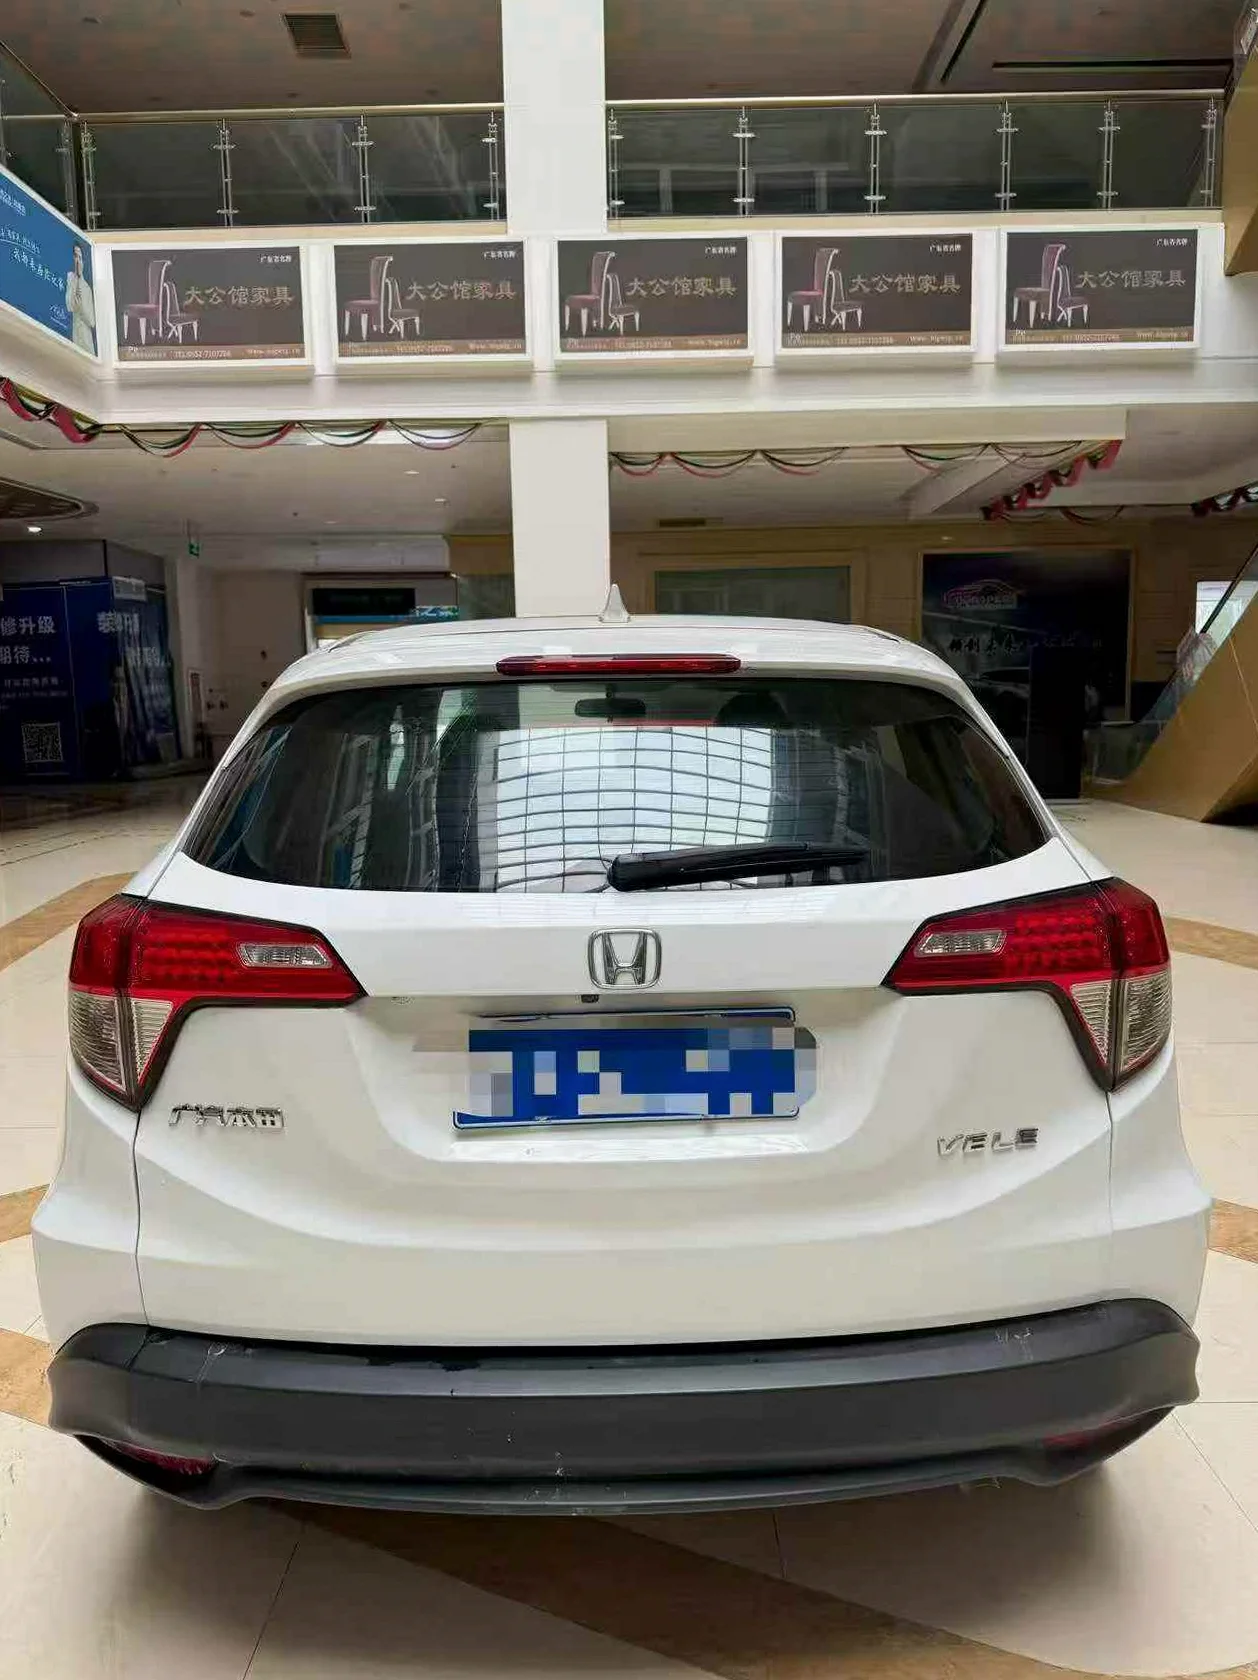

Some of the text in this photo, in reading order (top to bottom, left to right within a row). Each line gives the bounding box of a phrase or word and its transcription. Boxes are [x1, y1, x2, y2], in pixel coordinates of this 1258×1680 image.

[625, 276, 737, 297] 大公馆家具
[849, 273, 961, 294] 大公馆家具
[1075, 269, 1187, 288] 大公馆家具
[184, 285, 294, 306] 大公馆家具
[406, 280, 516, 300] 大公馆家具
